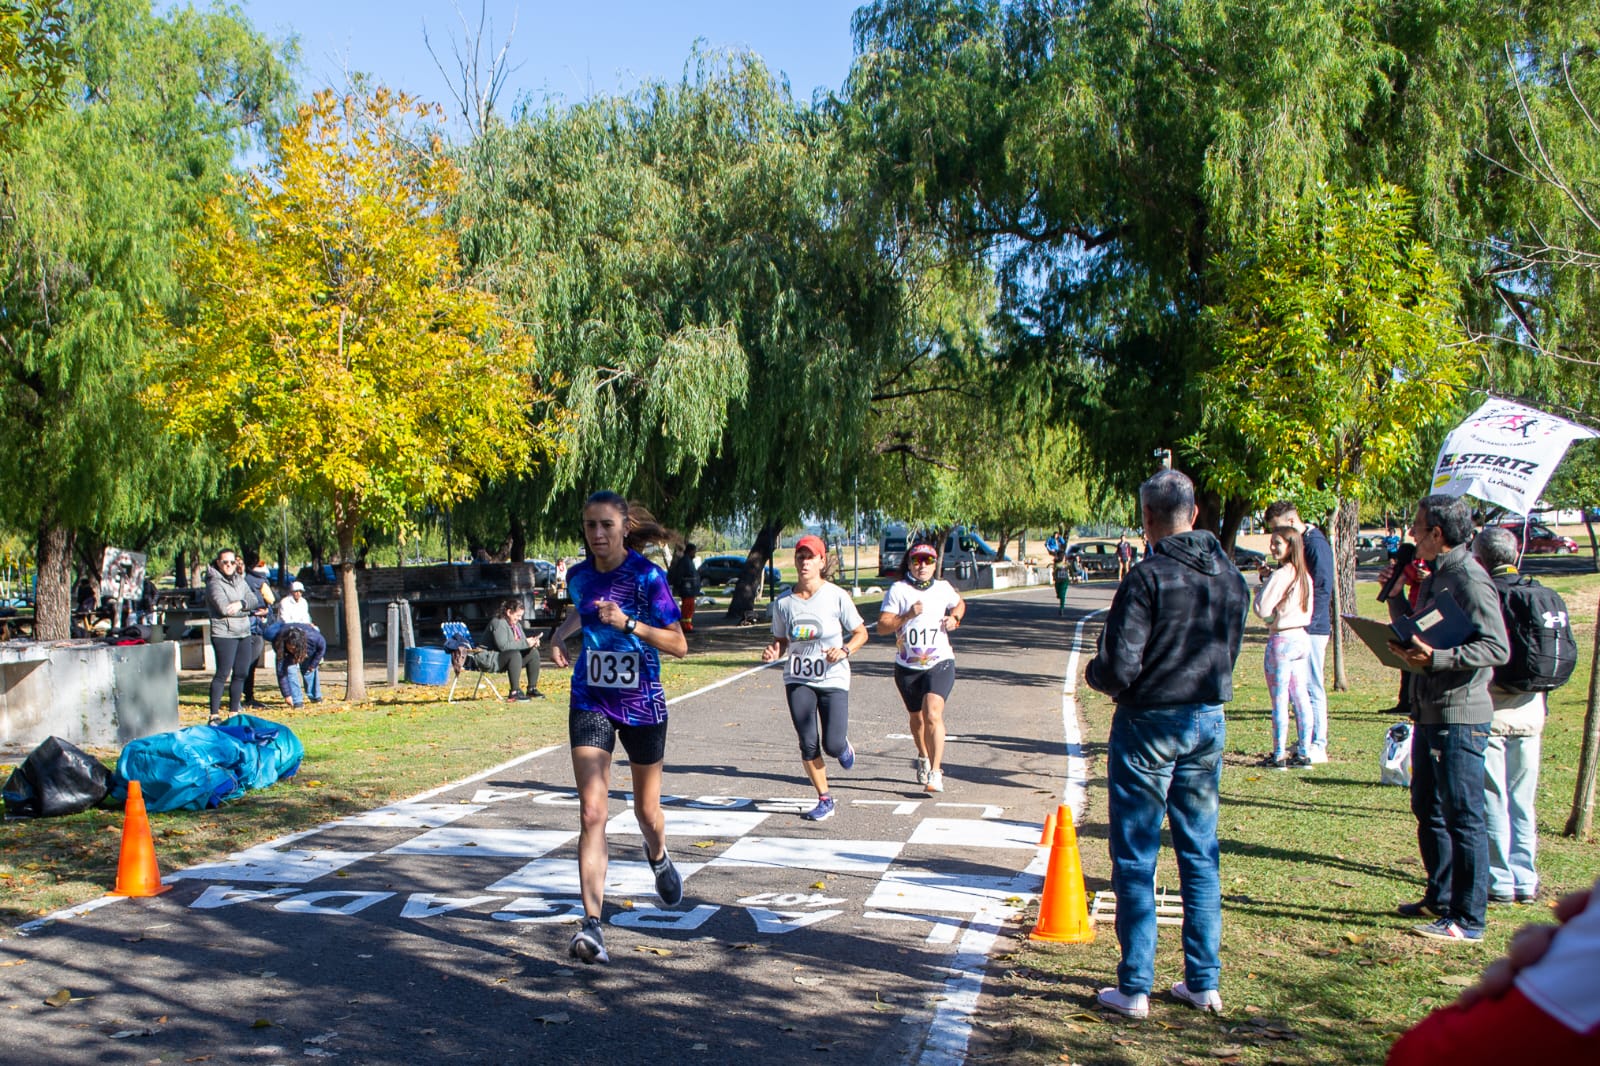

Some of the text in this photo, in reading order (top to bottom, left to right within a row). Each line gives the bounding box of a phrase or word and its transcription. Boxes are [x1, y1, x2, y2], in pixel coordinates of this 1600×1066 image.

[1456, 453, 1540, 475] STERTZ
[908, 628, 938, 646] 017
[590, 653, 636, 685] 033
[793, 656, 825, 677] 030
[188, 886, 961, 944] LARGADA
